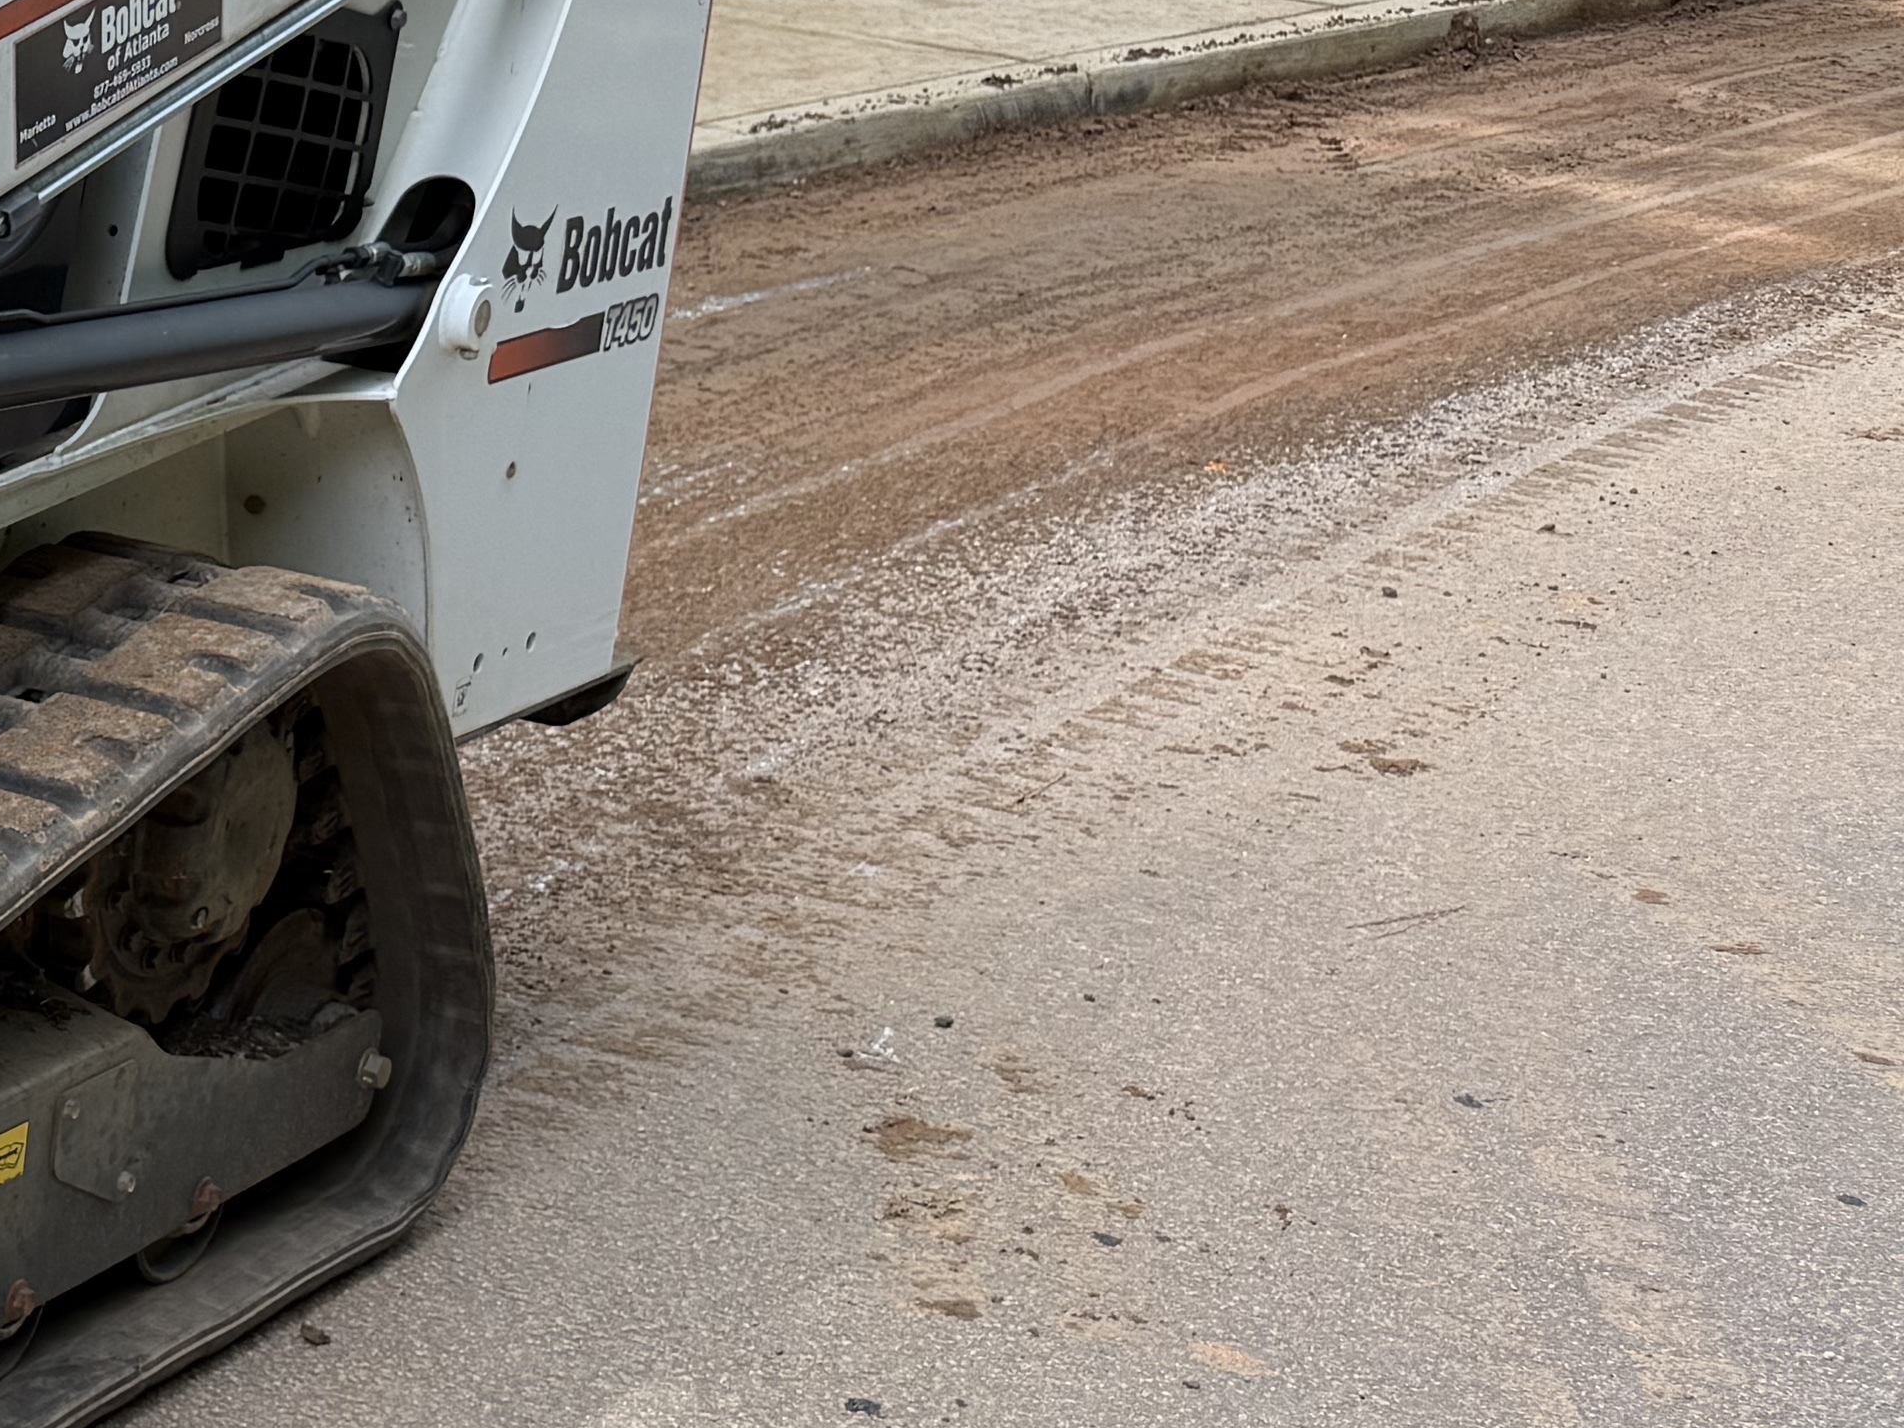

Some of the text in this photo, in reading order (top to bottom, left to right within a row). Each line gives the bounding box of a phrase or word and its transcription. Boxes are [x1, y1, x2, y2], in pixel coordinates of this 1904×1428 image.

[107, 22, 171, 71] of Atlanta
[19, 114, 57, 144] Marietta
[555, 195, 673, 295] Bobcat
[602, 292, 660, 352] T450
